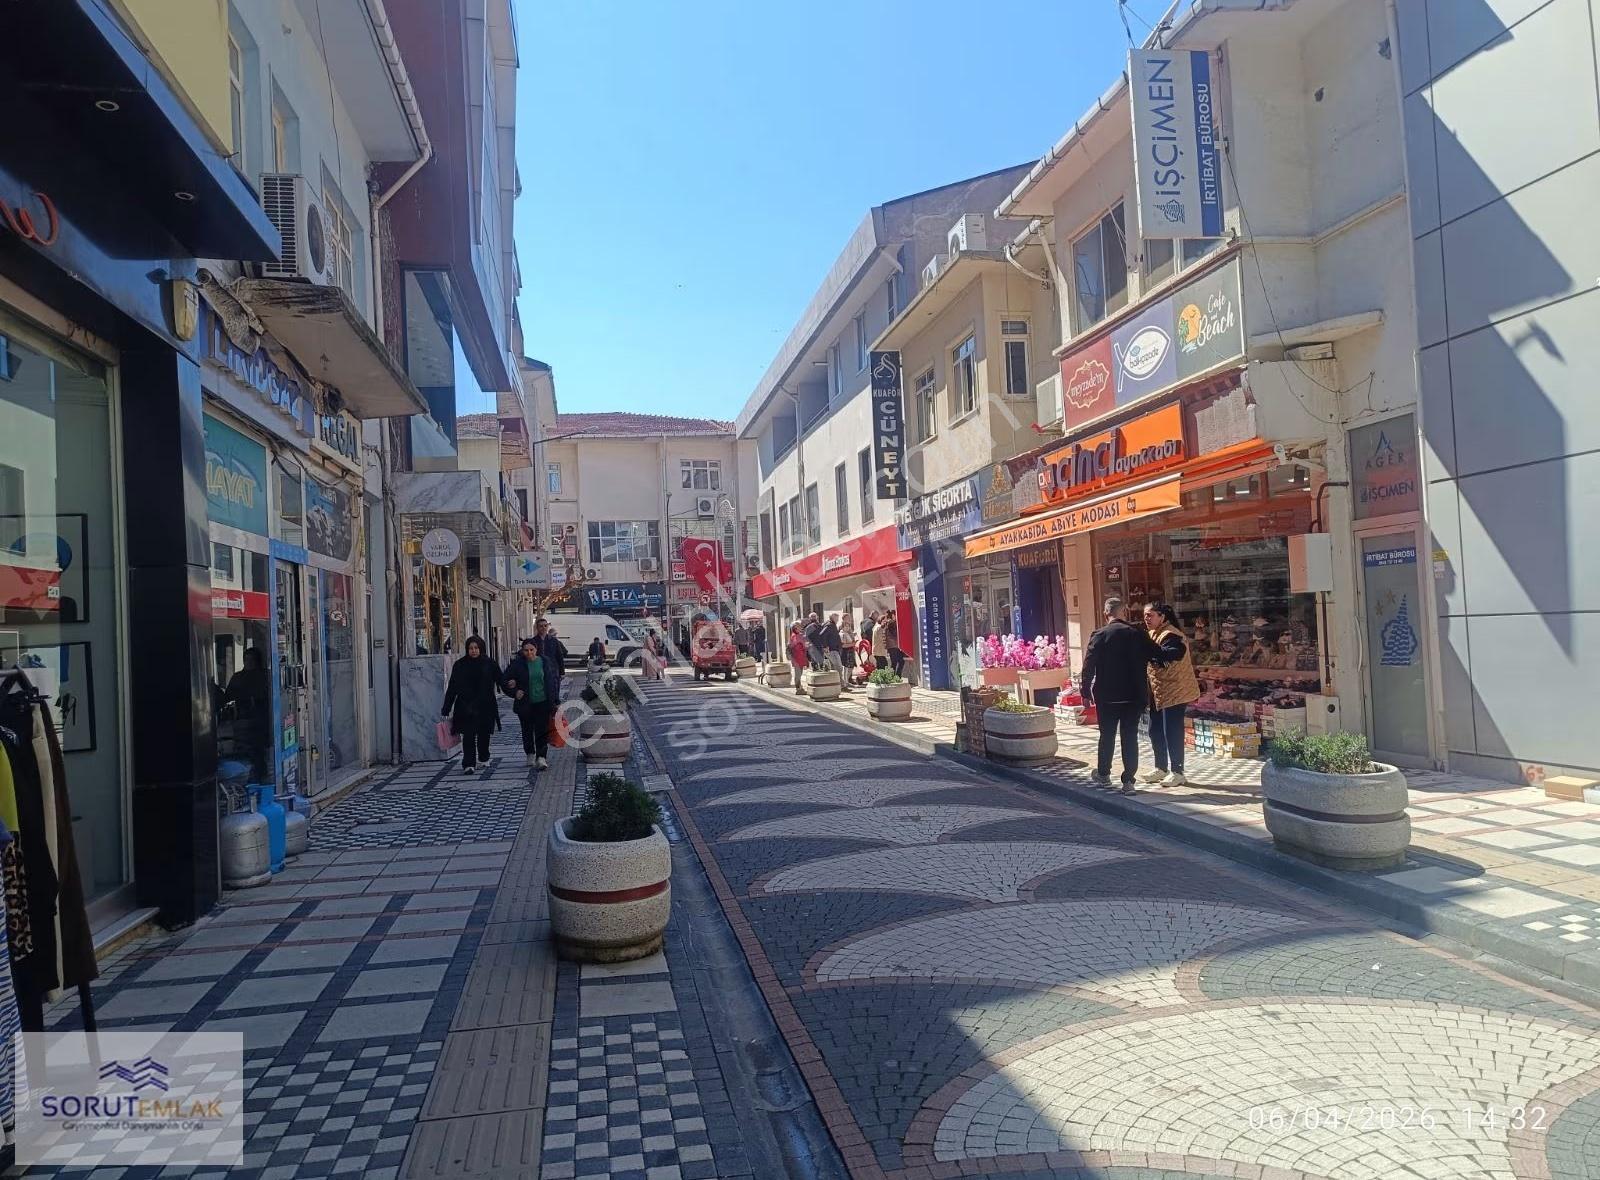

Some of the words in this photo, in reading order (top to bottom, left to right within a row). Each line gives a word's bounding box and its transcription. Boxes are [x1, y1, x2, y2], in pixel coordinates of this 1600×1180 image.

[1146, 59, 1185, 195] İŞÇİMEN
[1197, 83, 1213, 145] BÜROSU
[1200, 150, 1217, 205] İRTİBAT
[1197, 301, 1235, 347] Beach
[873, 387, 900, 398] KUAFÖR
[879, 401, 900, 496] CÜNEYT
[932, 479, 973, 512] SİGORTA
[1000, 524, 1048, 545] AYAKKABIDA
[1051, 516, 1077, 534] ABİYE
[1081, 502, 1120, 525] MODASI
[601, 588, 639, 601] BETA
